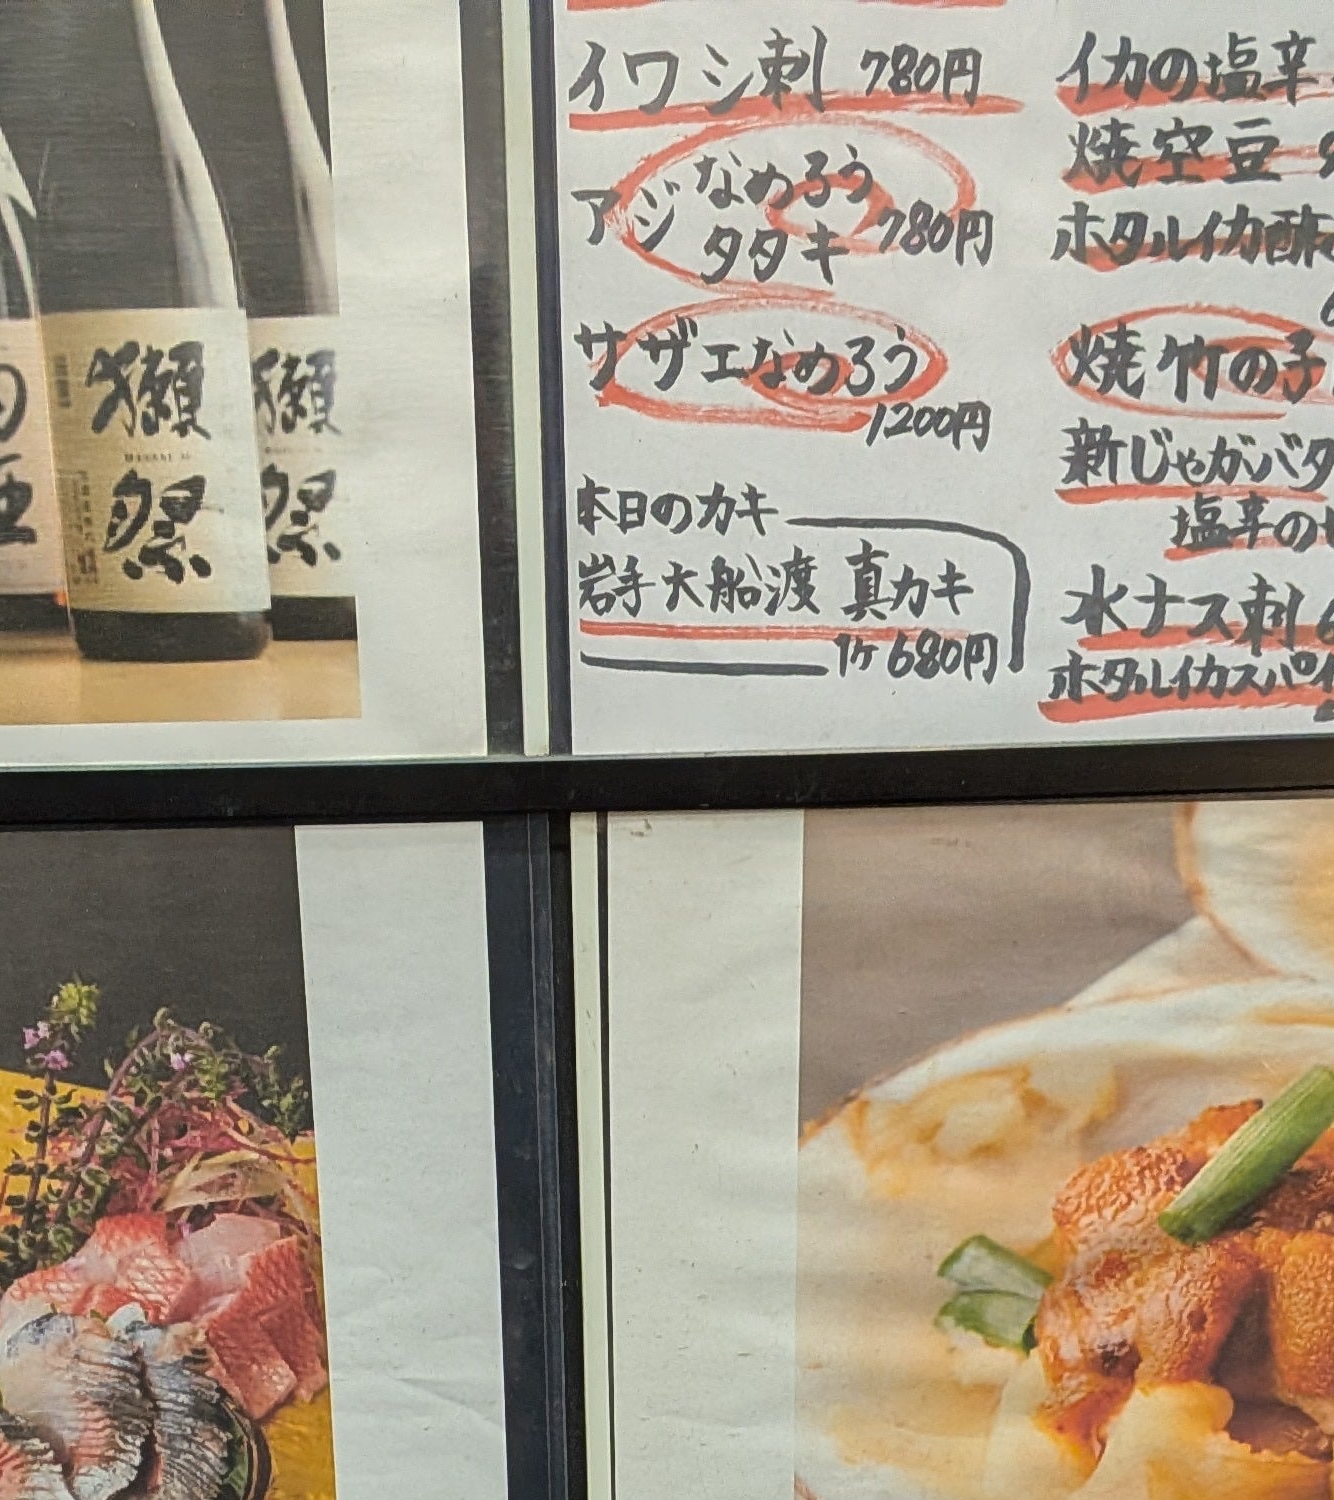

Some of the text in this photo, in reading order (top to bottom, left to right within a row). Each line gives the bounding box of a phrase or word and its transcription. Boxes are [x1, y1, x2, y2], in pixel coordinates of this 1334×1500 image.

[568, 26, 982, 115] イワシ刺 780円
[1056, 30, 1318, 105] イカの塩辛
[693, 144, 873, 208] なめろう
[1067, 117, 1282, 188] 焼空豆
[571, 179, 680, 251] アジ
[701, 200, 994, 285] タタキ 780円
[574, 315, 918, 396] サザエなめろう
[85, 340, 211, 584] 獺祭
[867, 400, 992, 452] 1200円
[577, 474, 779, 535] 本日のカキ
[578, 539, 973, 621] 岩手大船渡 真カキ
[1061, 564, 1306, 657] 水ナス刺
